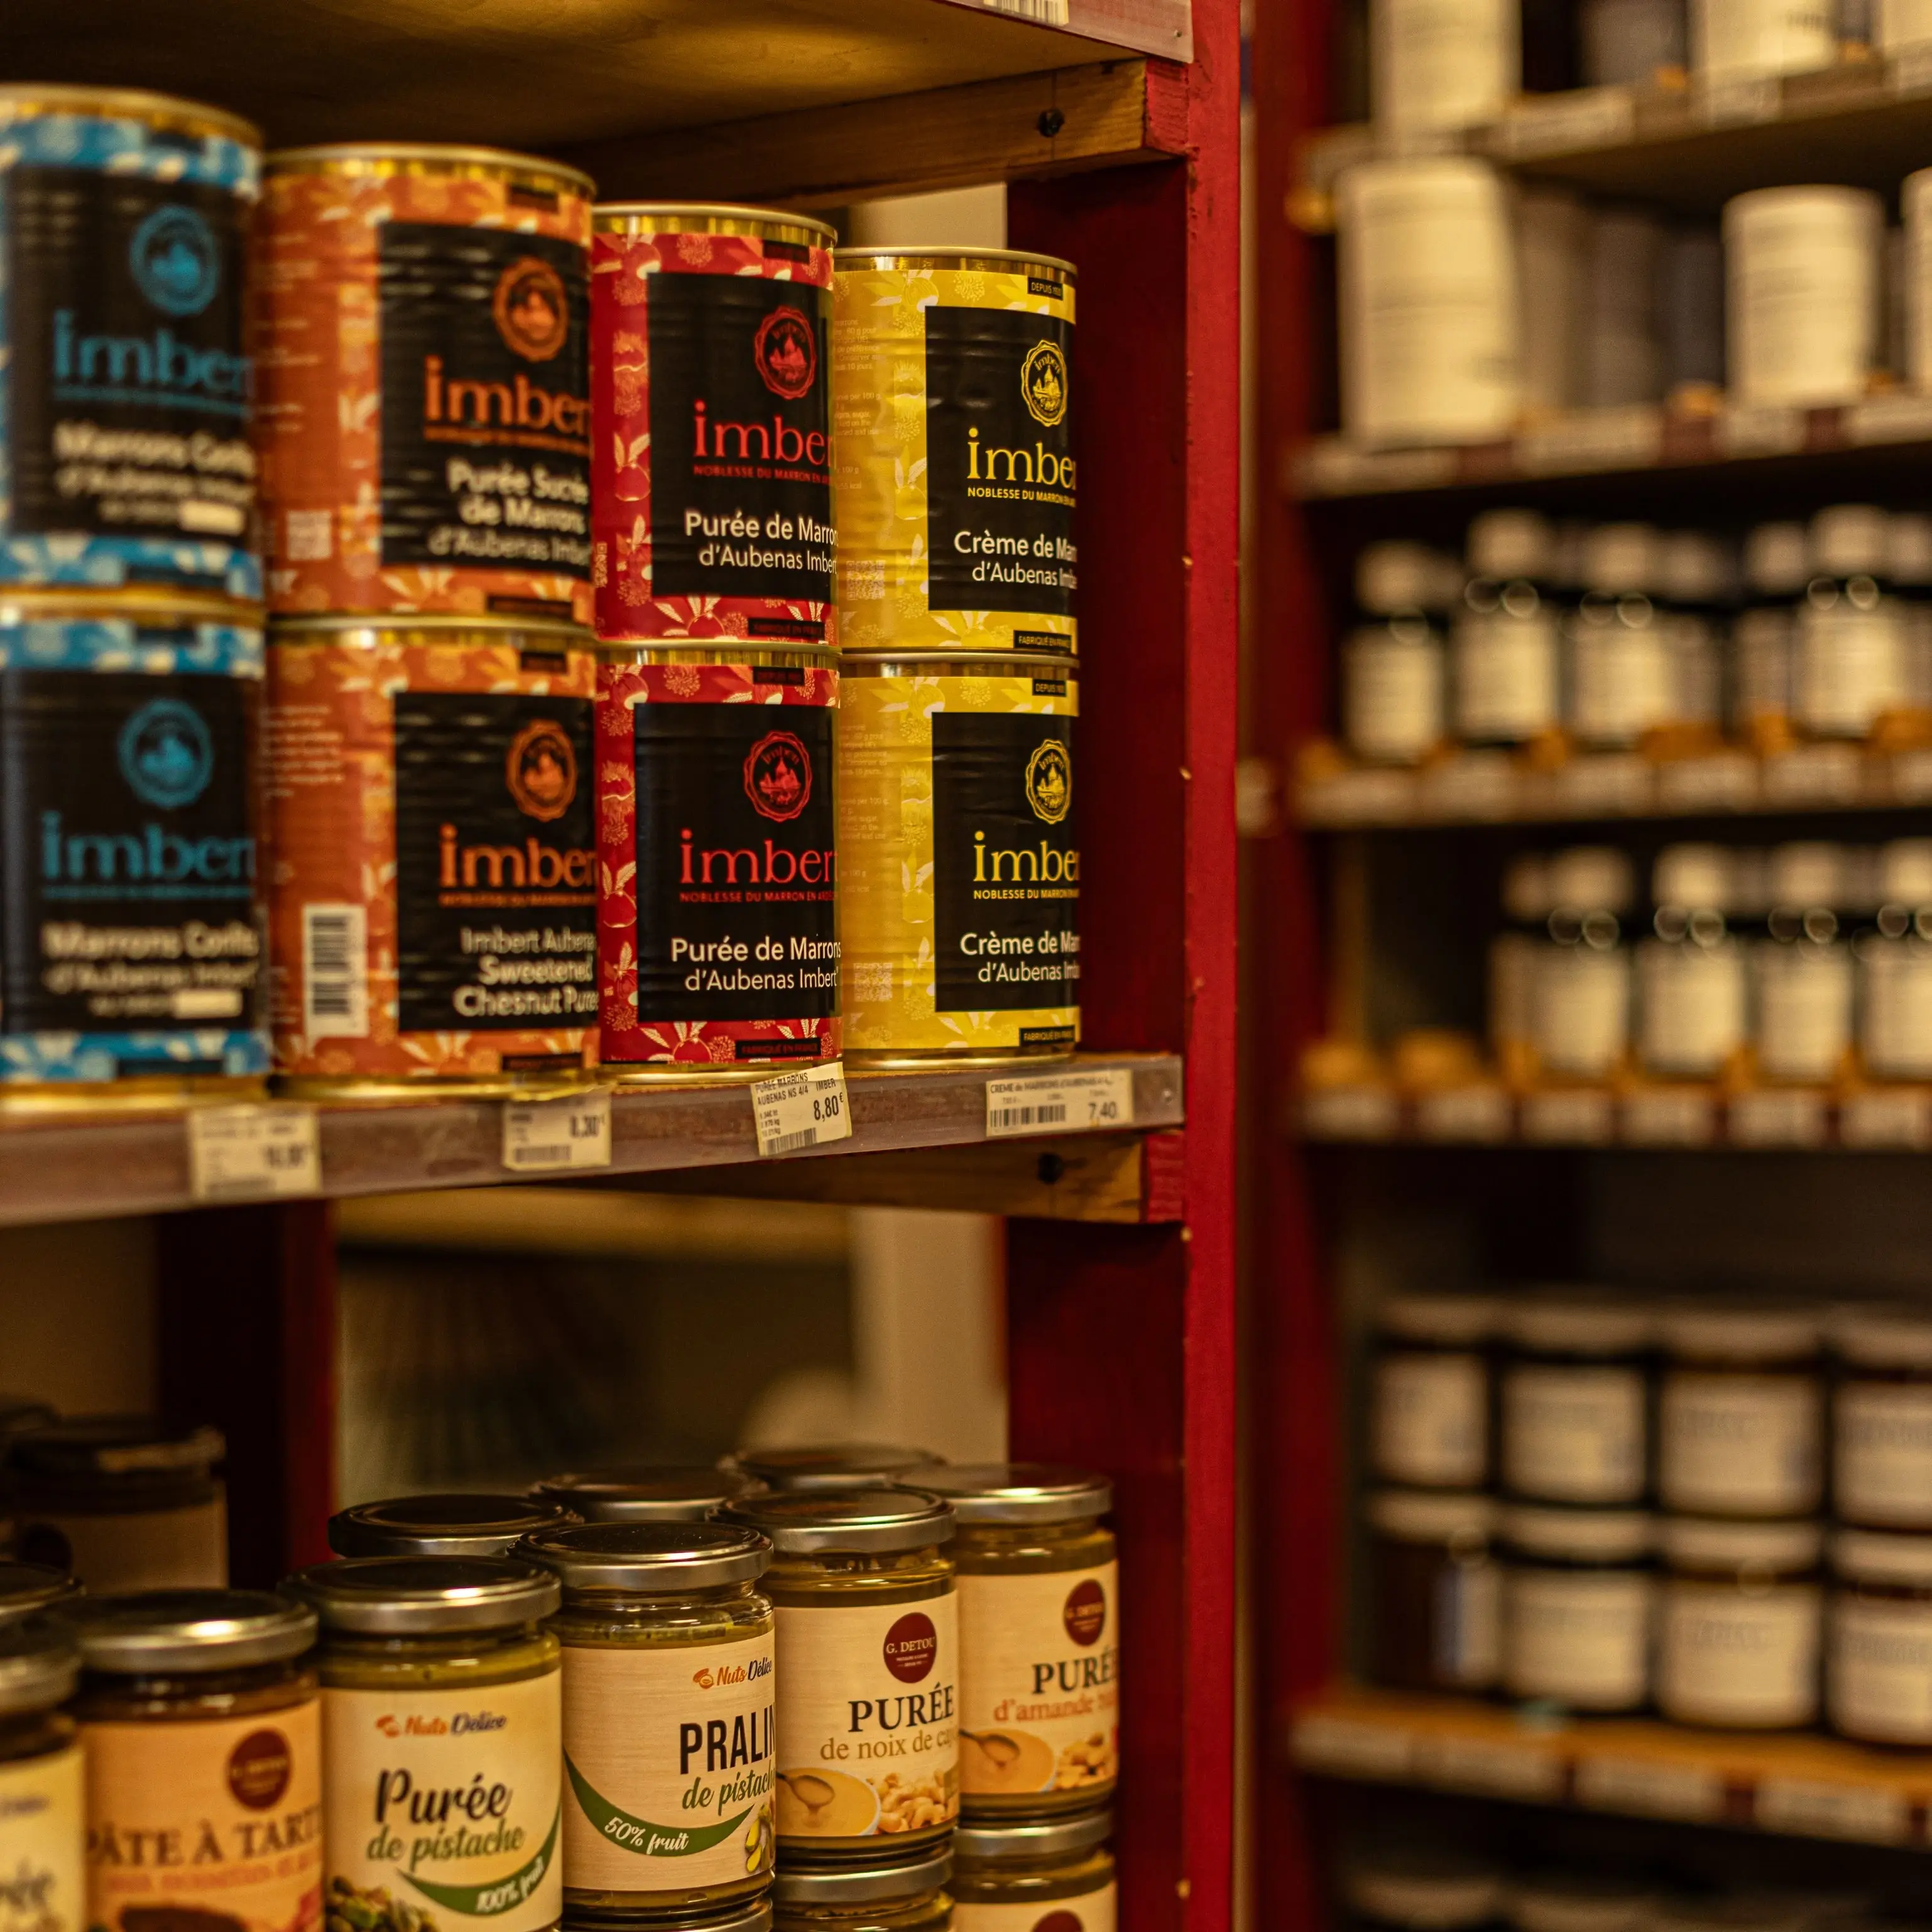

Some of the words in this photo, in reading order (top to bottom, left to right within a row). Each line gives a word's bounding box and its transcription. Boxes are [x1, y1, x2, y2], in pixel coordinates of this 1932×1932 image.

[968, 487, 1020, 499] NOBLESSE
[1022, 489, 1034, 501] DU
[684, 510, 760, 538] Purée
[766, 511, 793, 540] de
[699, 543, 803, 570] d'Aubenas
[954, 528, 1029, 556] Crème
[1033, 533, 1054, 558] de
[972, 560, 1058, 587] d'Aubenas
[680, 891, 742, 903] NOBLESSE
[745, 891, 761, 902] DU
[764, 890, 805, 902] MARRON
[974, 889, 1025, 899] NOBLESSE
[1027, 889, 1039, 899] DU
[670, 935, 748, 962] Purée
[755, 936, 784, 961] de
[790, 936, 841, 960] Marrons
[960, 930, 1034, 956] Crème
[1037, 930, 1058, 954] de
[685, 968, 794, 991] d'Aubenas
[978, 960, 1062, 983] d'Aubenas
[777, 1072, 809, 1088] MARRONS
[758, 1091, 787, 1106] AUBENAS
[788, 1088, 797, 1098] NS
[799, 1085, 809, 1096] 4/4
[717, 1665, 747, 1686] Nuts
[848, 1681, 954, 1733] PURÉE
[679, 1702, 775, 1776] PRALIN
[819, 1737, 849, 1760] de
[857, 1733, 907, 1759] noix
[912, 1728, 933, 1754] de
[374, 1767, 514, 1825] Purée
[682, 1777, 715, 1810] de
[366, 1824, 404, 1861] de
[409, 1817, 527, 1874] pistache
[604, 1816, 646, 1847] 50%
[646, 1831, 690, 1855] fruit
